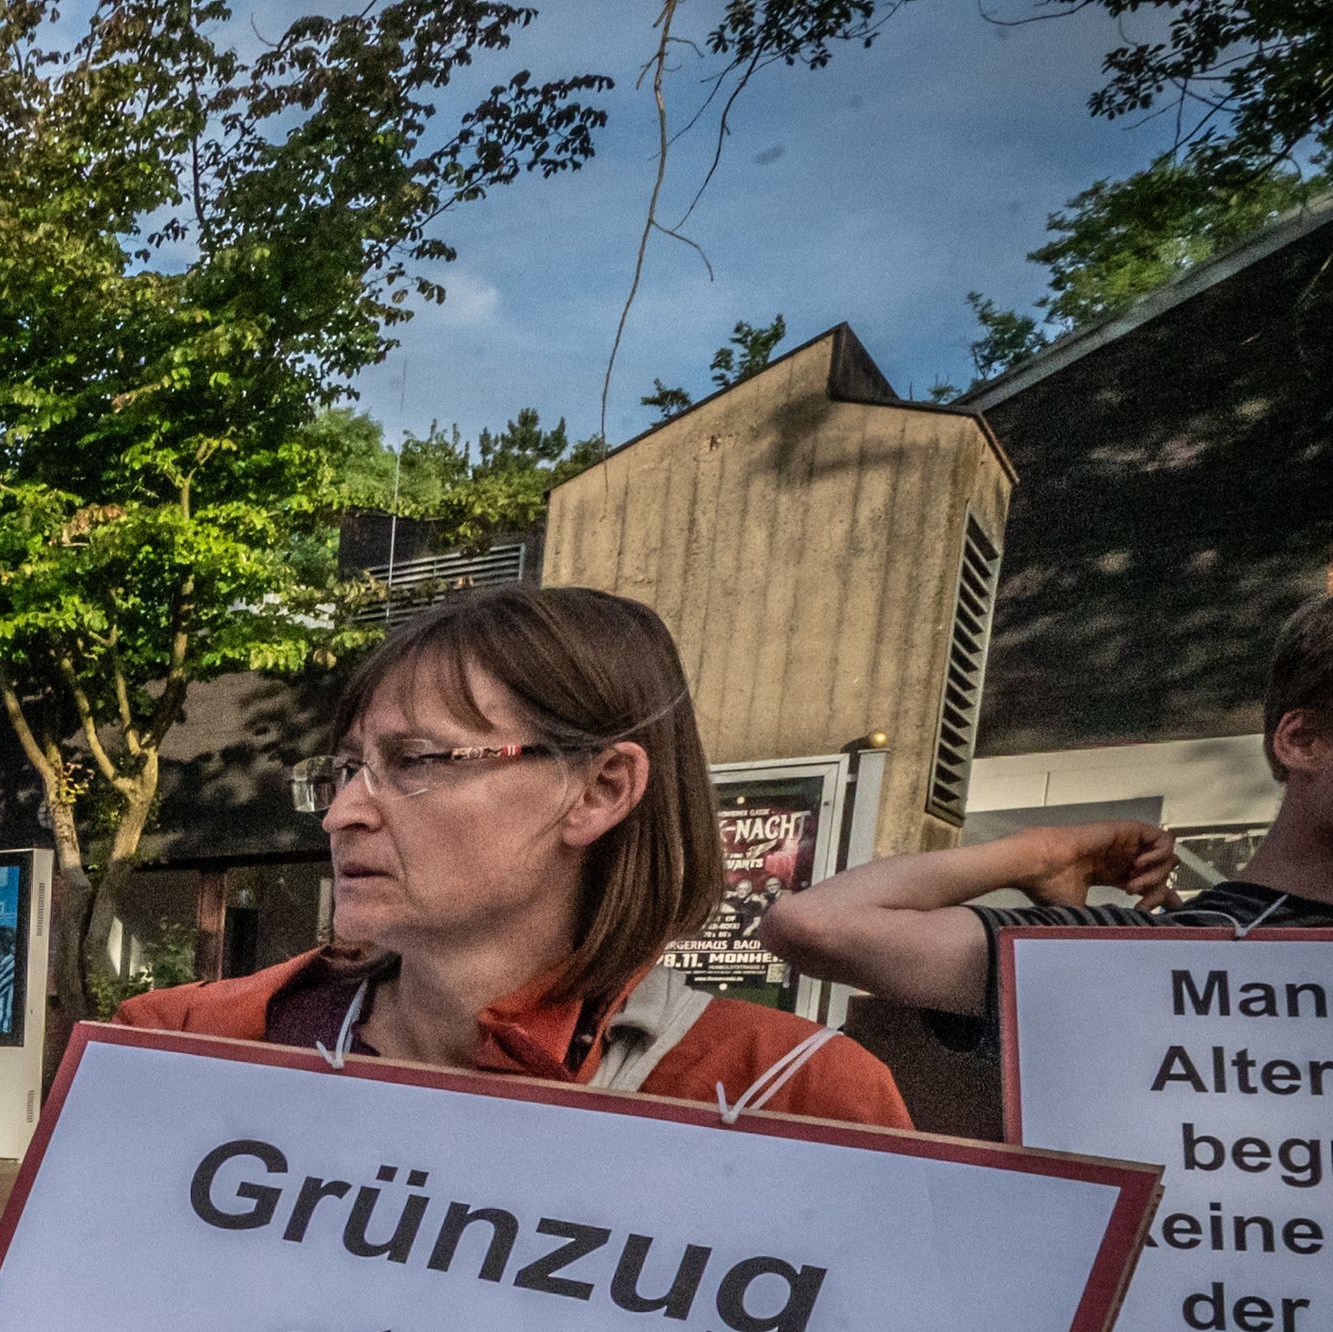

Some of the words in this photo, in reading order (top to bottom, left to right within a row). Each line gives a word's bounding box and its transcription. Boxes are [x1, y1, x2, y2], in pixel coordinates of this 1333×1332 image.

[709, 952, 784, 963] MONHE
[1170, 969, 1329, 1019] Man
[1181, 1122, 1333, 1189] beg
